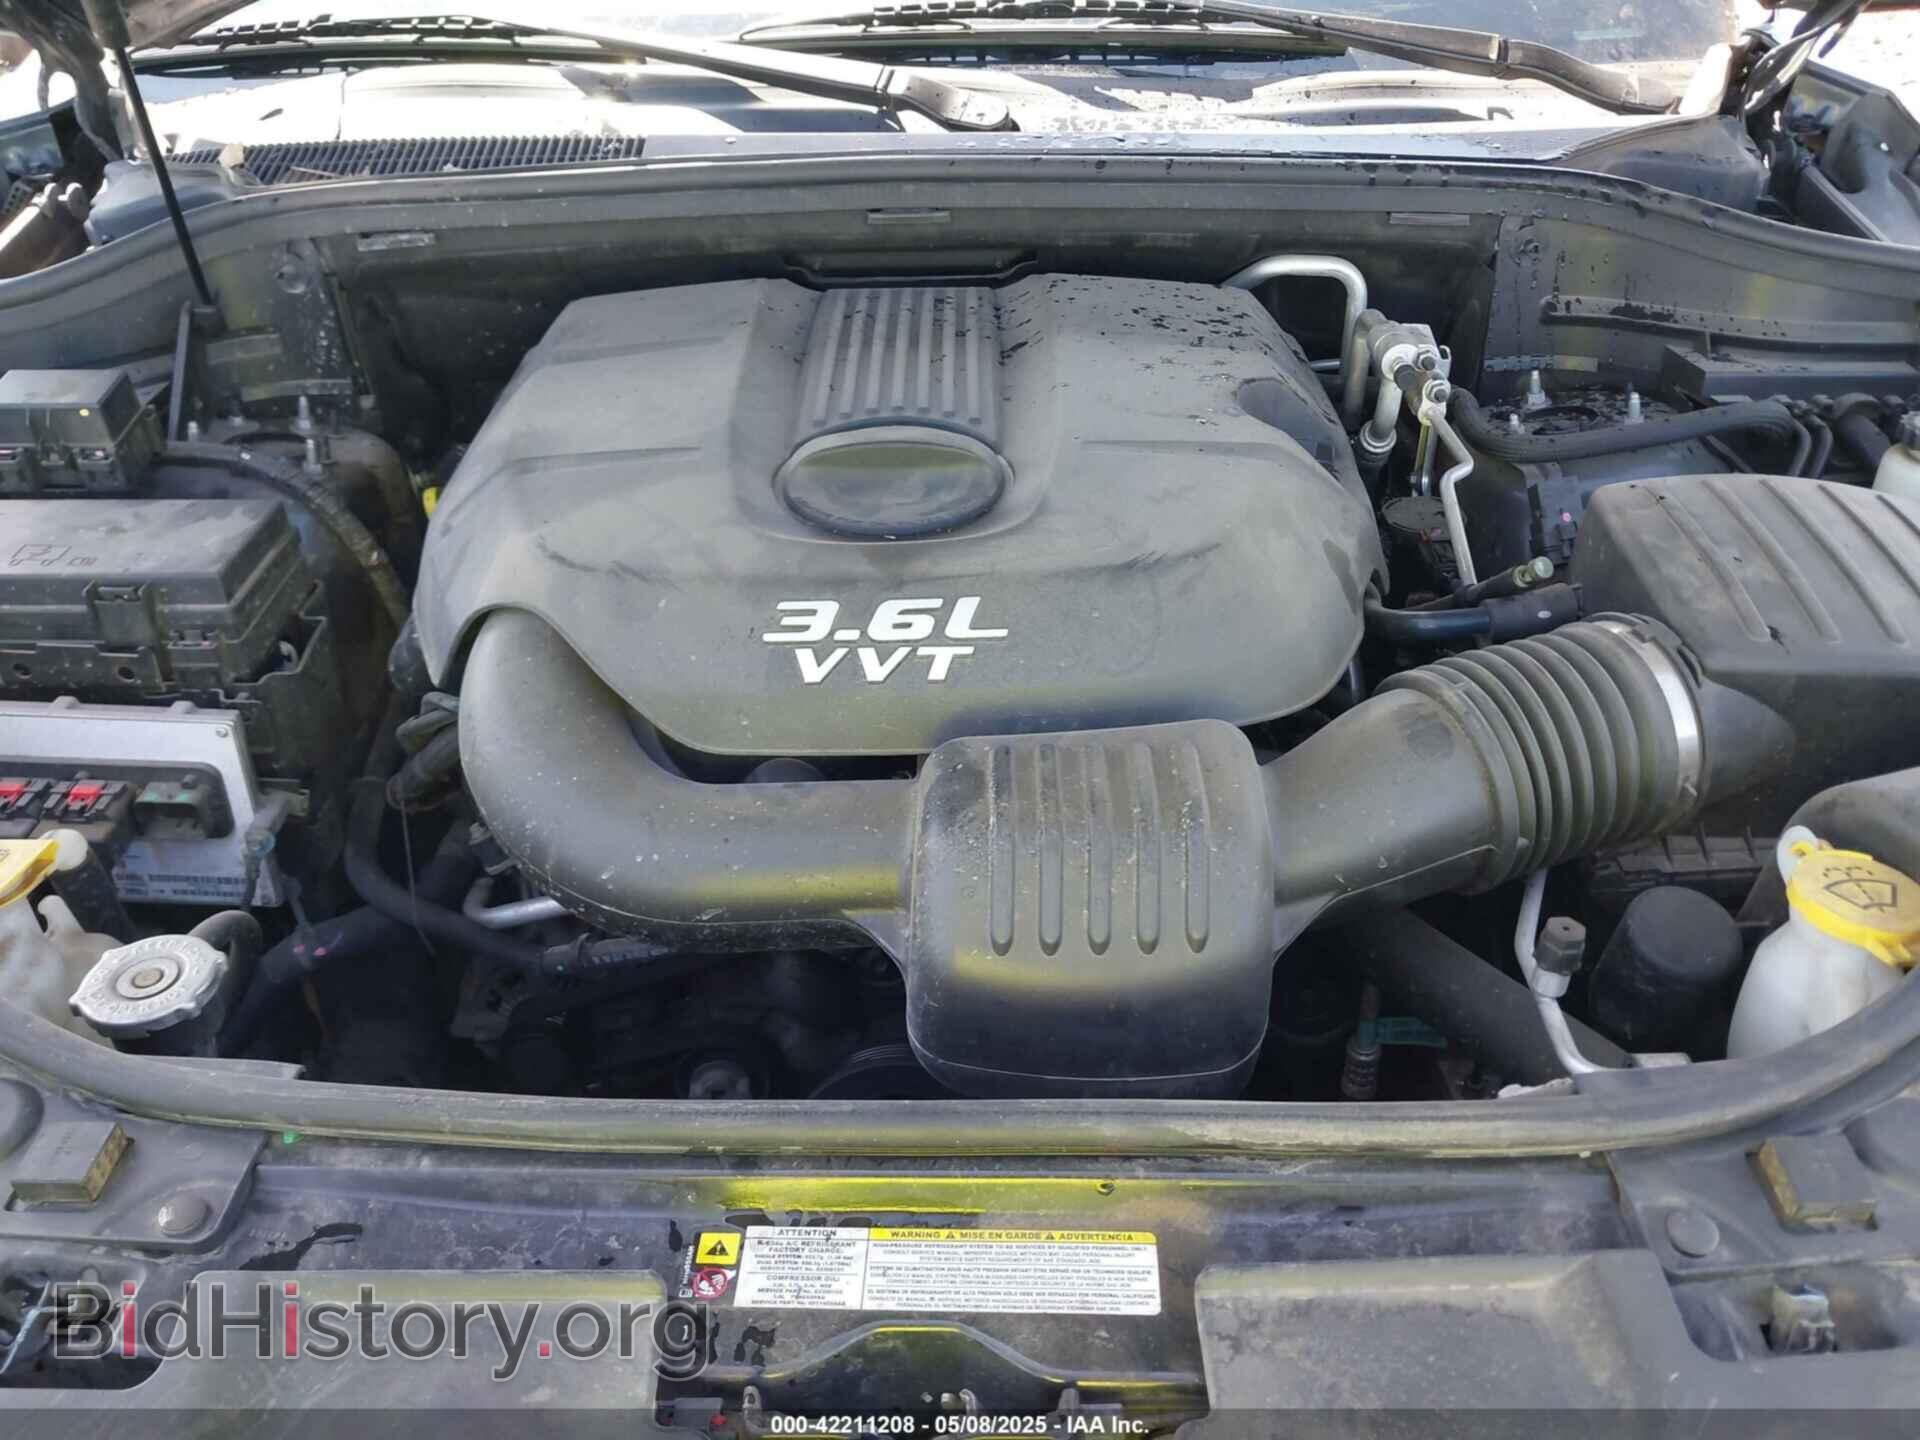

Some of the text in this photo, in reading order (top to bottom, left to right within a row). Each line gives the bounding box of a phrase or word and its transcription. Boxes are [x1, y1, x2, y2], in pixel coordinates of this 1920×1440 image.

[762, 596, 1009, 642] 3.6L
[794, 646, 975, 683] VVT
[777, 1229, 837, 1238] ATTENTION
[890, 1231, 941, 1239] WARNING
[960, 1231, 985, 1239] MISE
[1005, 1232, 1040, 1240] GARDE
[1060, 1232, 1134, 1241] ADVERTENCIA
